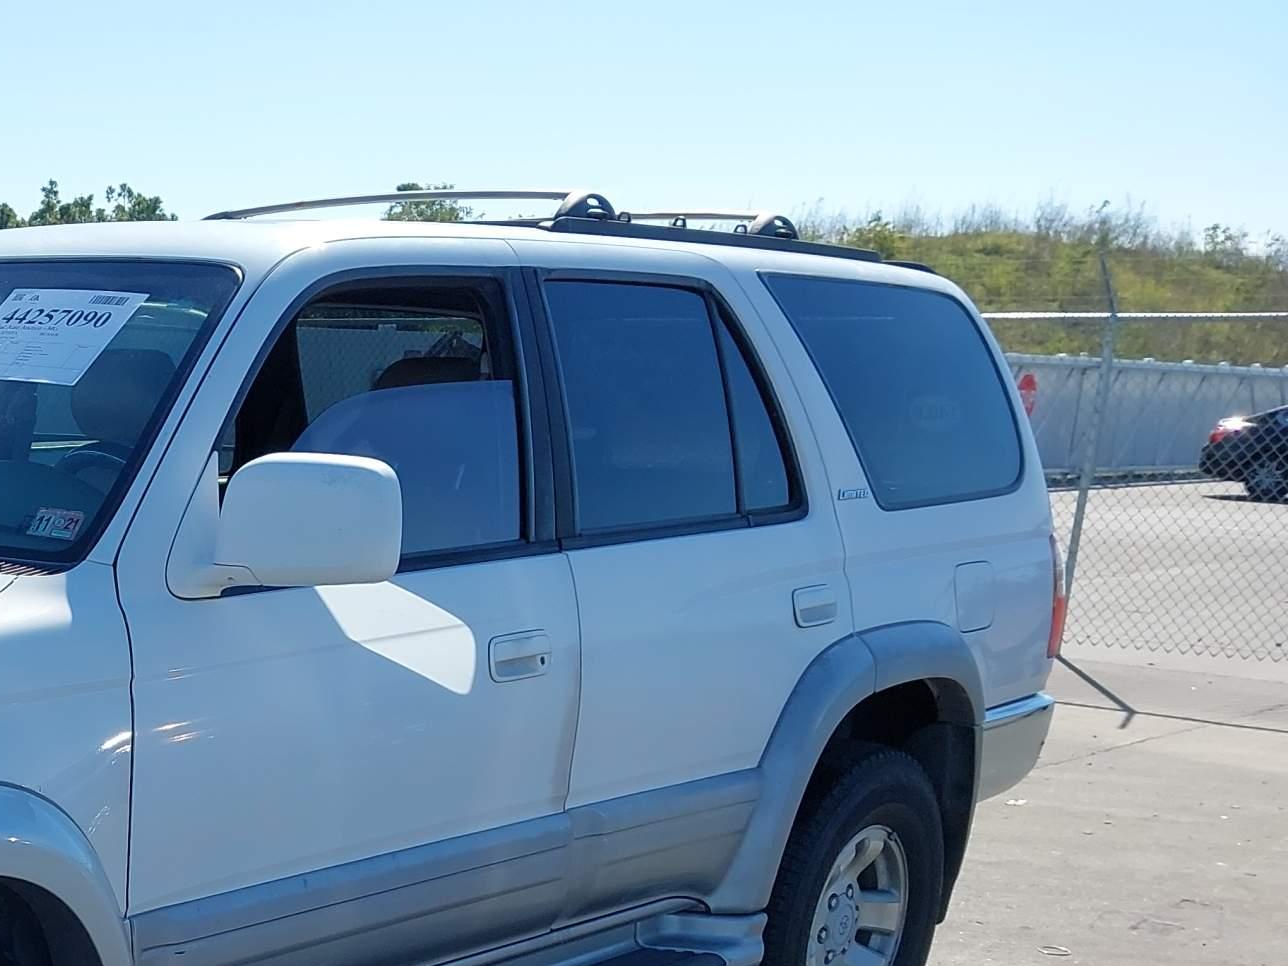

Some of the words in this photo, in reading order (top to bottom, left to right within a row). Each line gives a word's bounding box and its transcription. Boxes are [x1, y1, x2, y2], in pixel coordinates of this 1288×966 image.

[2, 307, 112, 328] 44257090
[35, 514, 53, 532] 11
[63, 517, 81, 530] 21
